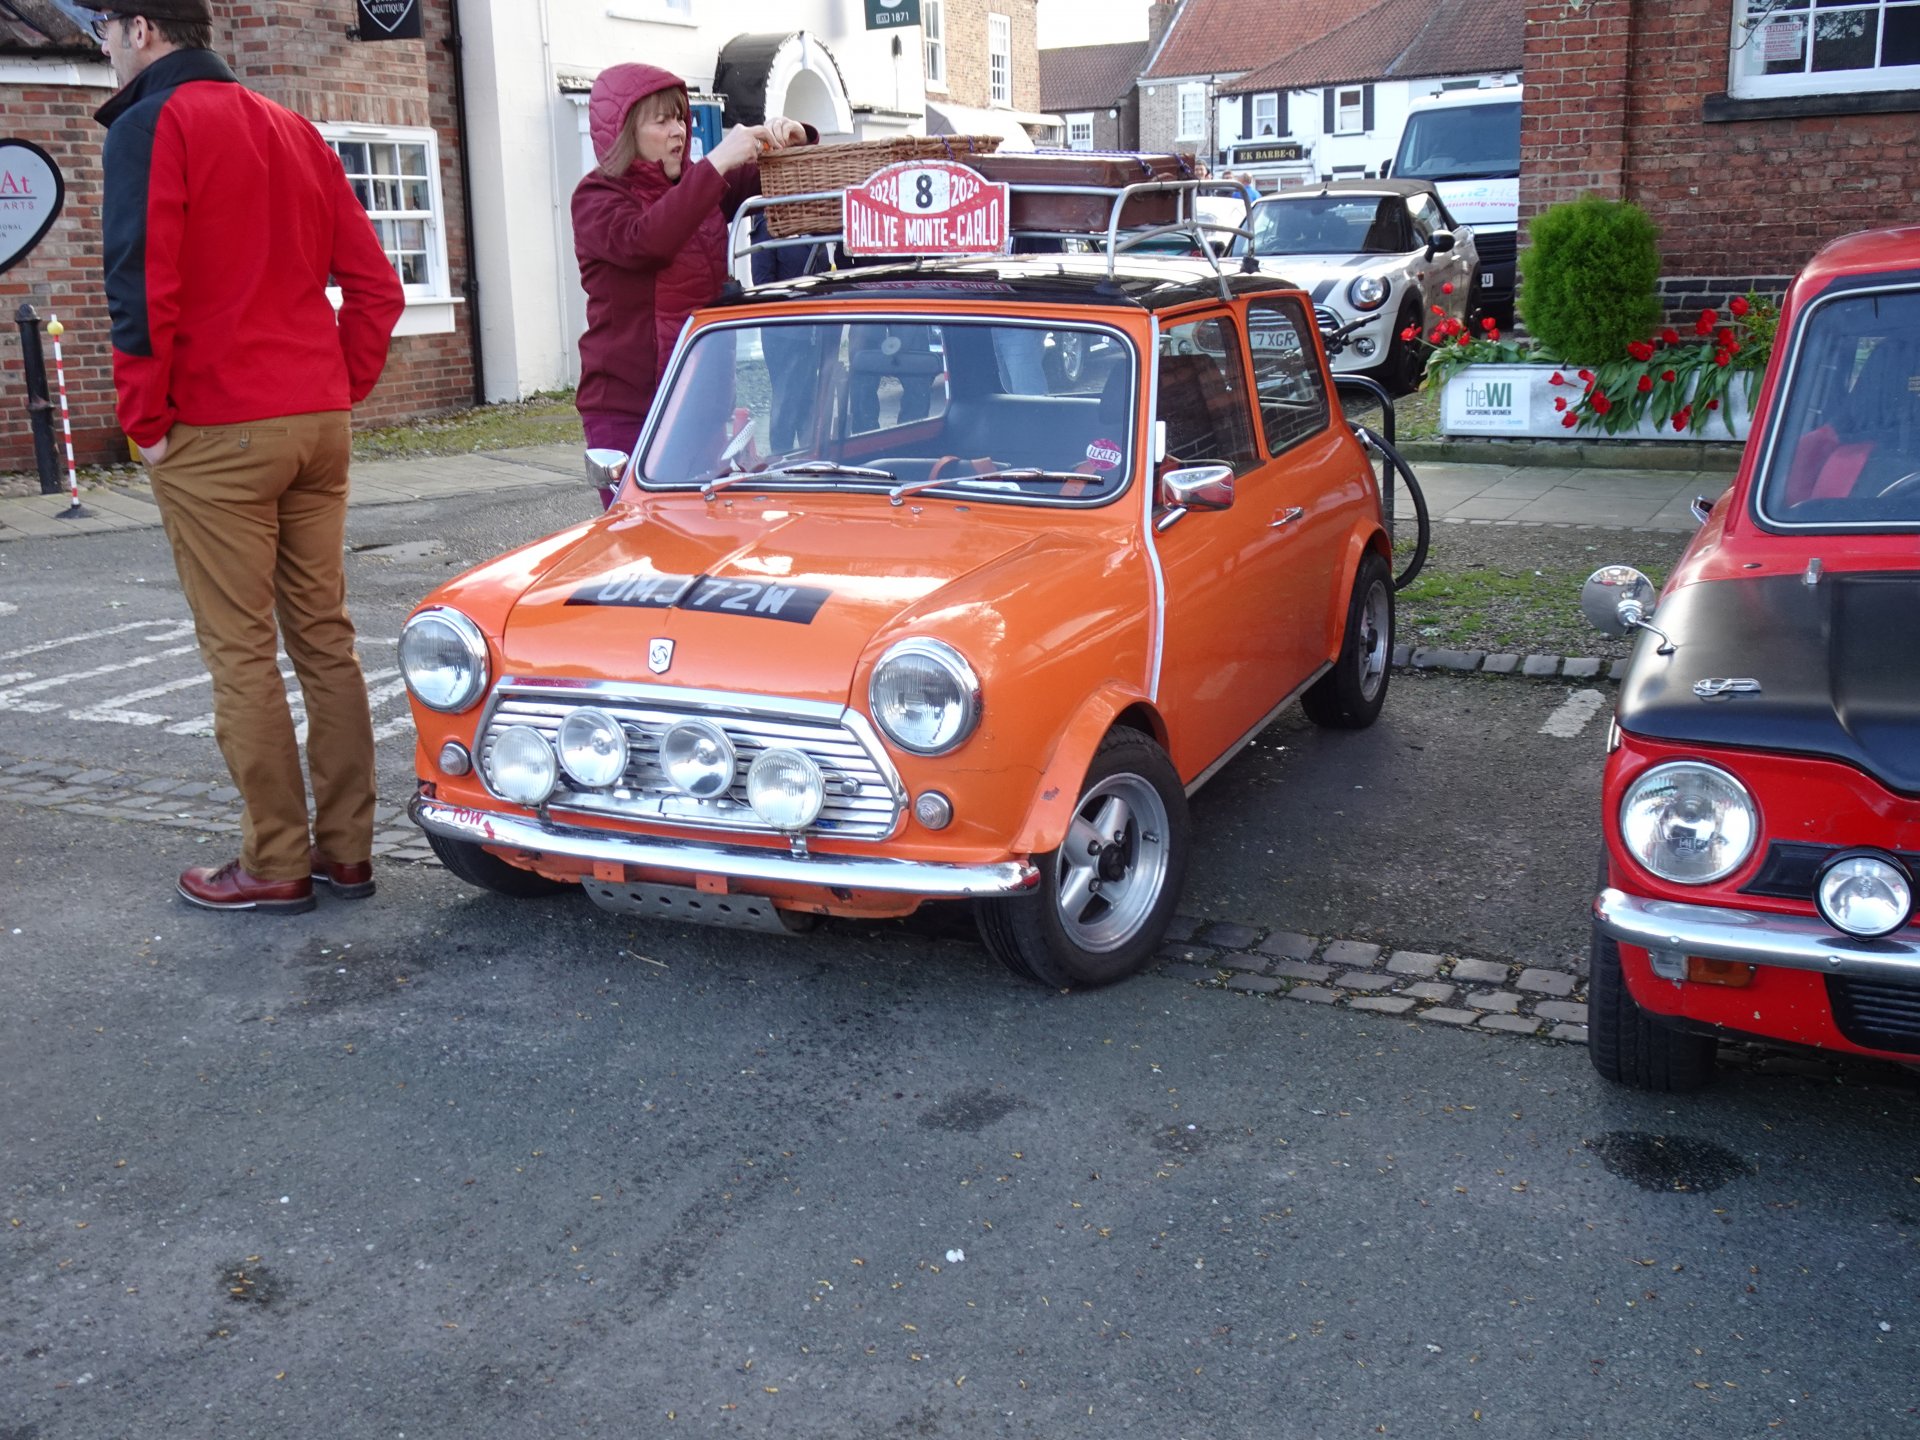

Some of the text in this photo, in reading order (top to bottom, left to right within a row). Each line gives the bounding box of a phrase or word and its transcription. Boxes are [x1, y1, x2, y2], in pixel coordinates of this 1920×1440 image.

[371, 3, 405, 14] BOUTIQUE
[890, 11, 909, 22] 1871
[869, 176, 899, 208] 2024
[915, 174, 934, 209] 8
[951, 175, 980, 207] 2024
[4, 201, 34, 210] ARTS
[851, 198, 999, 247] RALLYE MONTE-CARLO
[1268, 332, 1296, 347] XGR
[1088, 446, 1120, 463] ILKLEY
[597, 573, 798, 615] UMJ 72W
[453, 808, 486, 826] TOW
